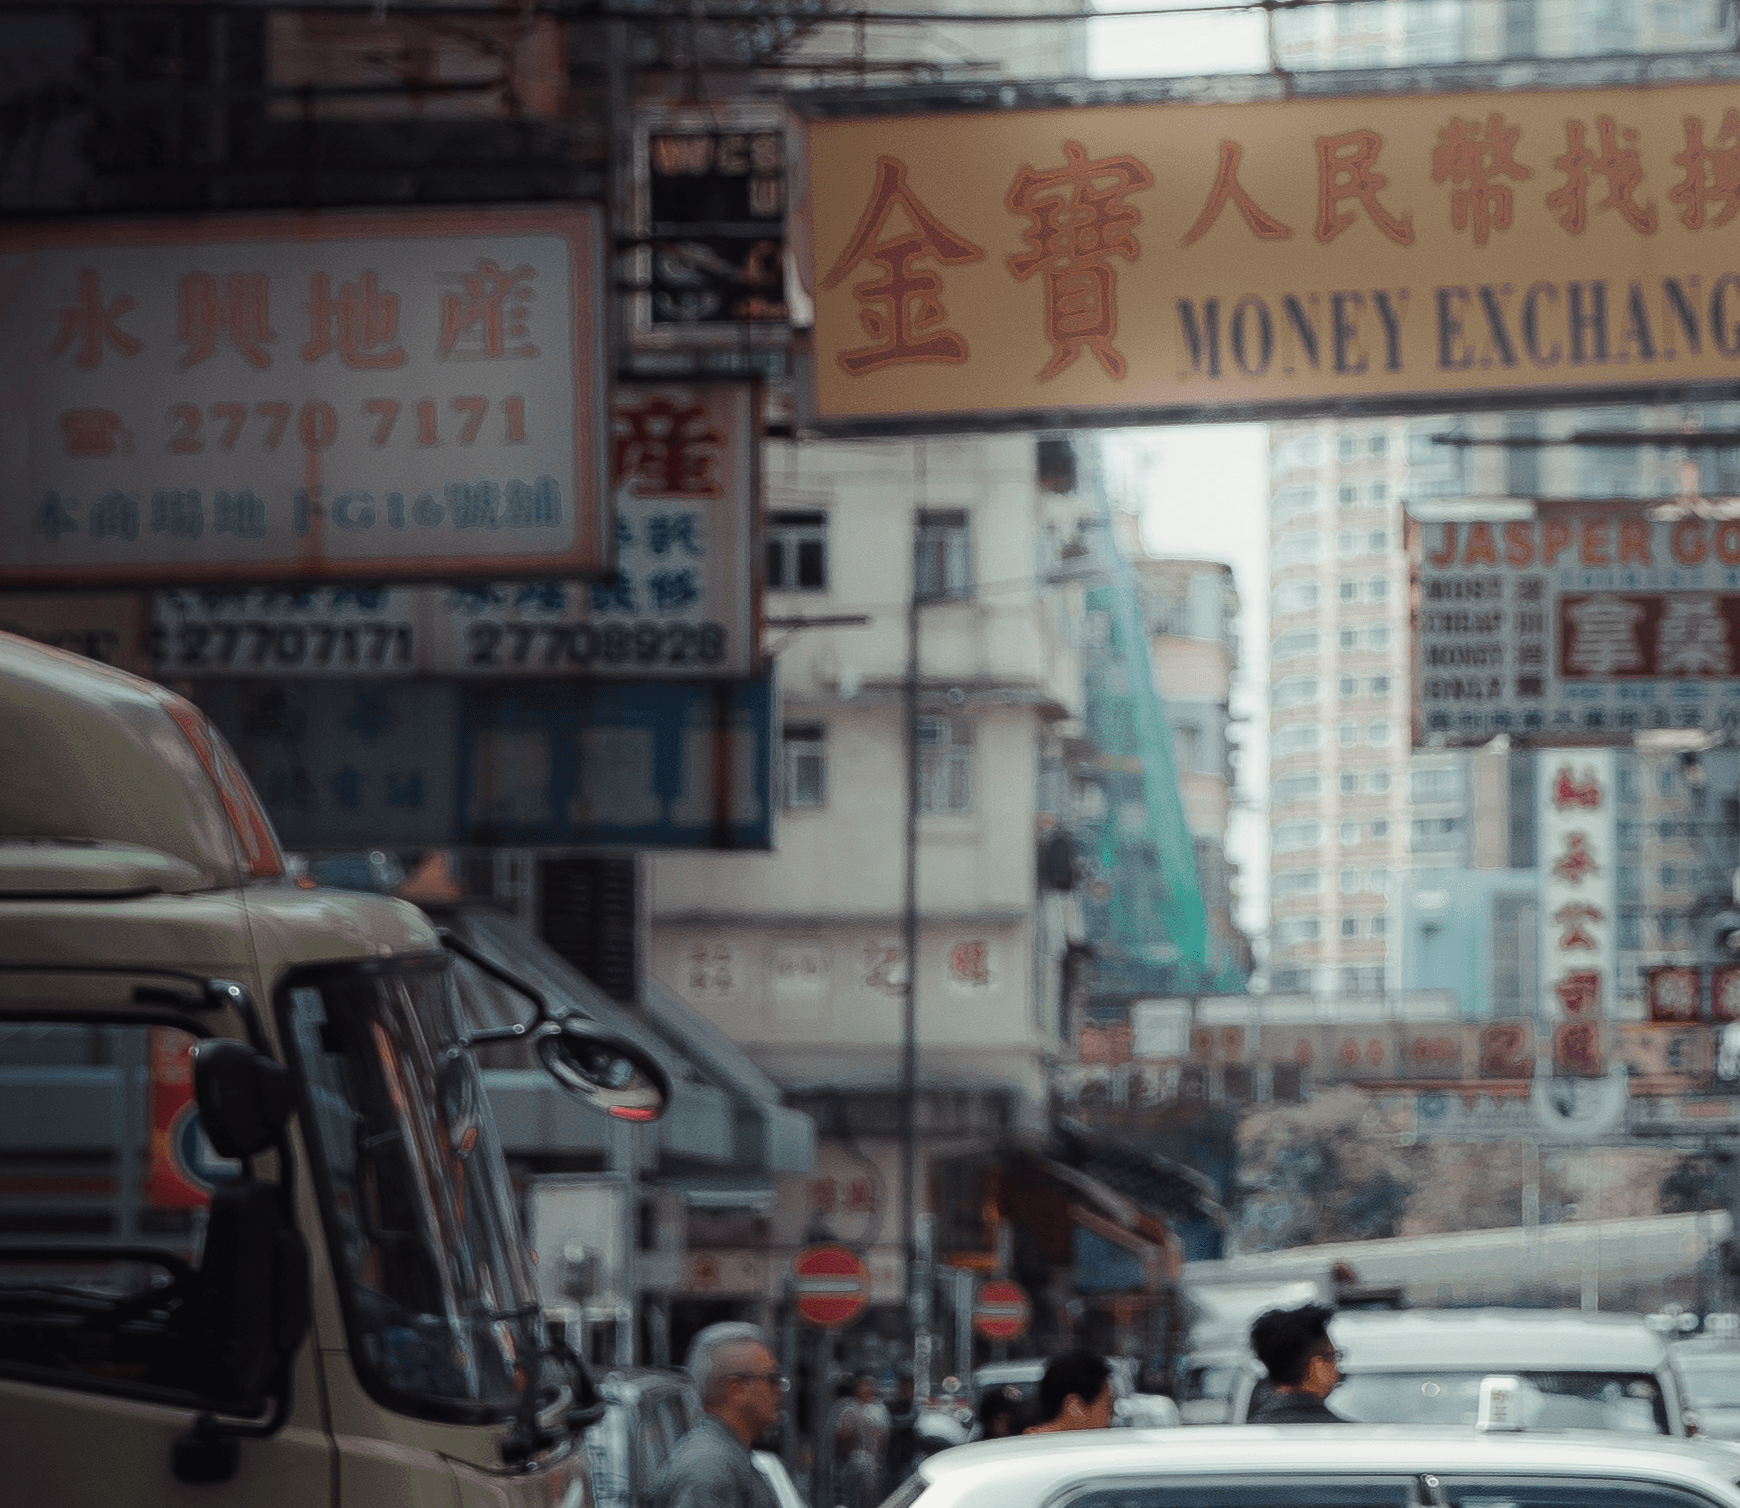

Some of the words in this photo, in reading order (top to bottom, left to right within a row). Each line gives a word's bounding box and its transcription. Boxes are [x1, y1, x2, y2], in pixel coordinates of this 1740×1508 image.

[1174, 285, 1410, 384] MONEY
[165, 398, 340, 455] 2770
[358, 394, 530, 450] 7171
[1426, 520, 1653, 568] JASPER
